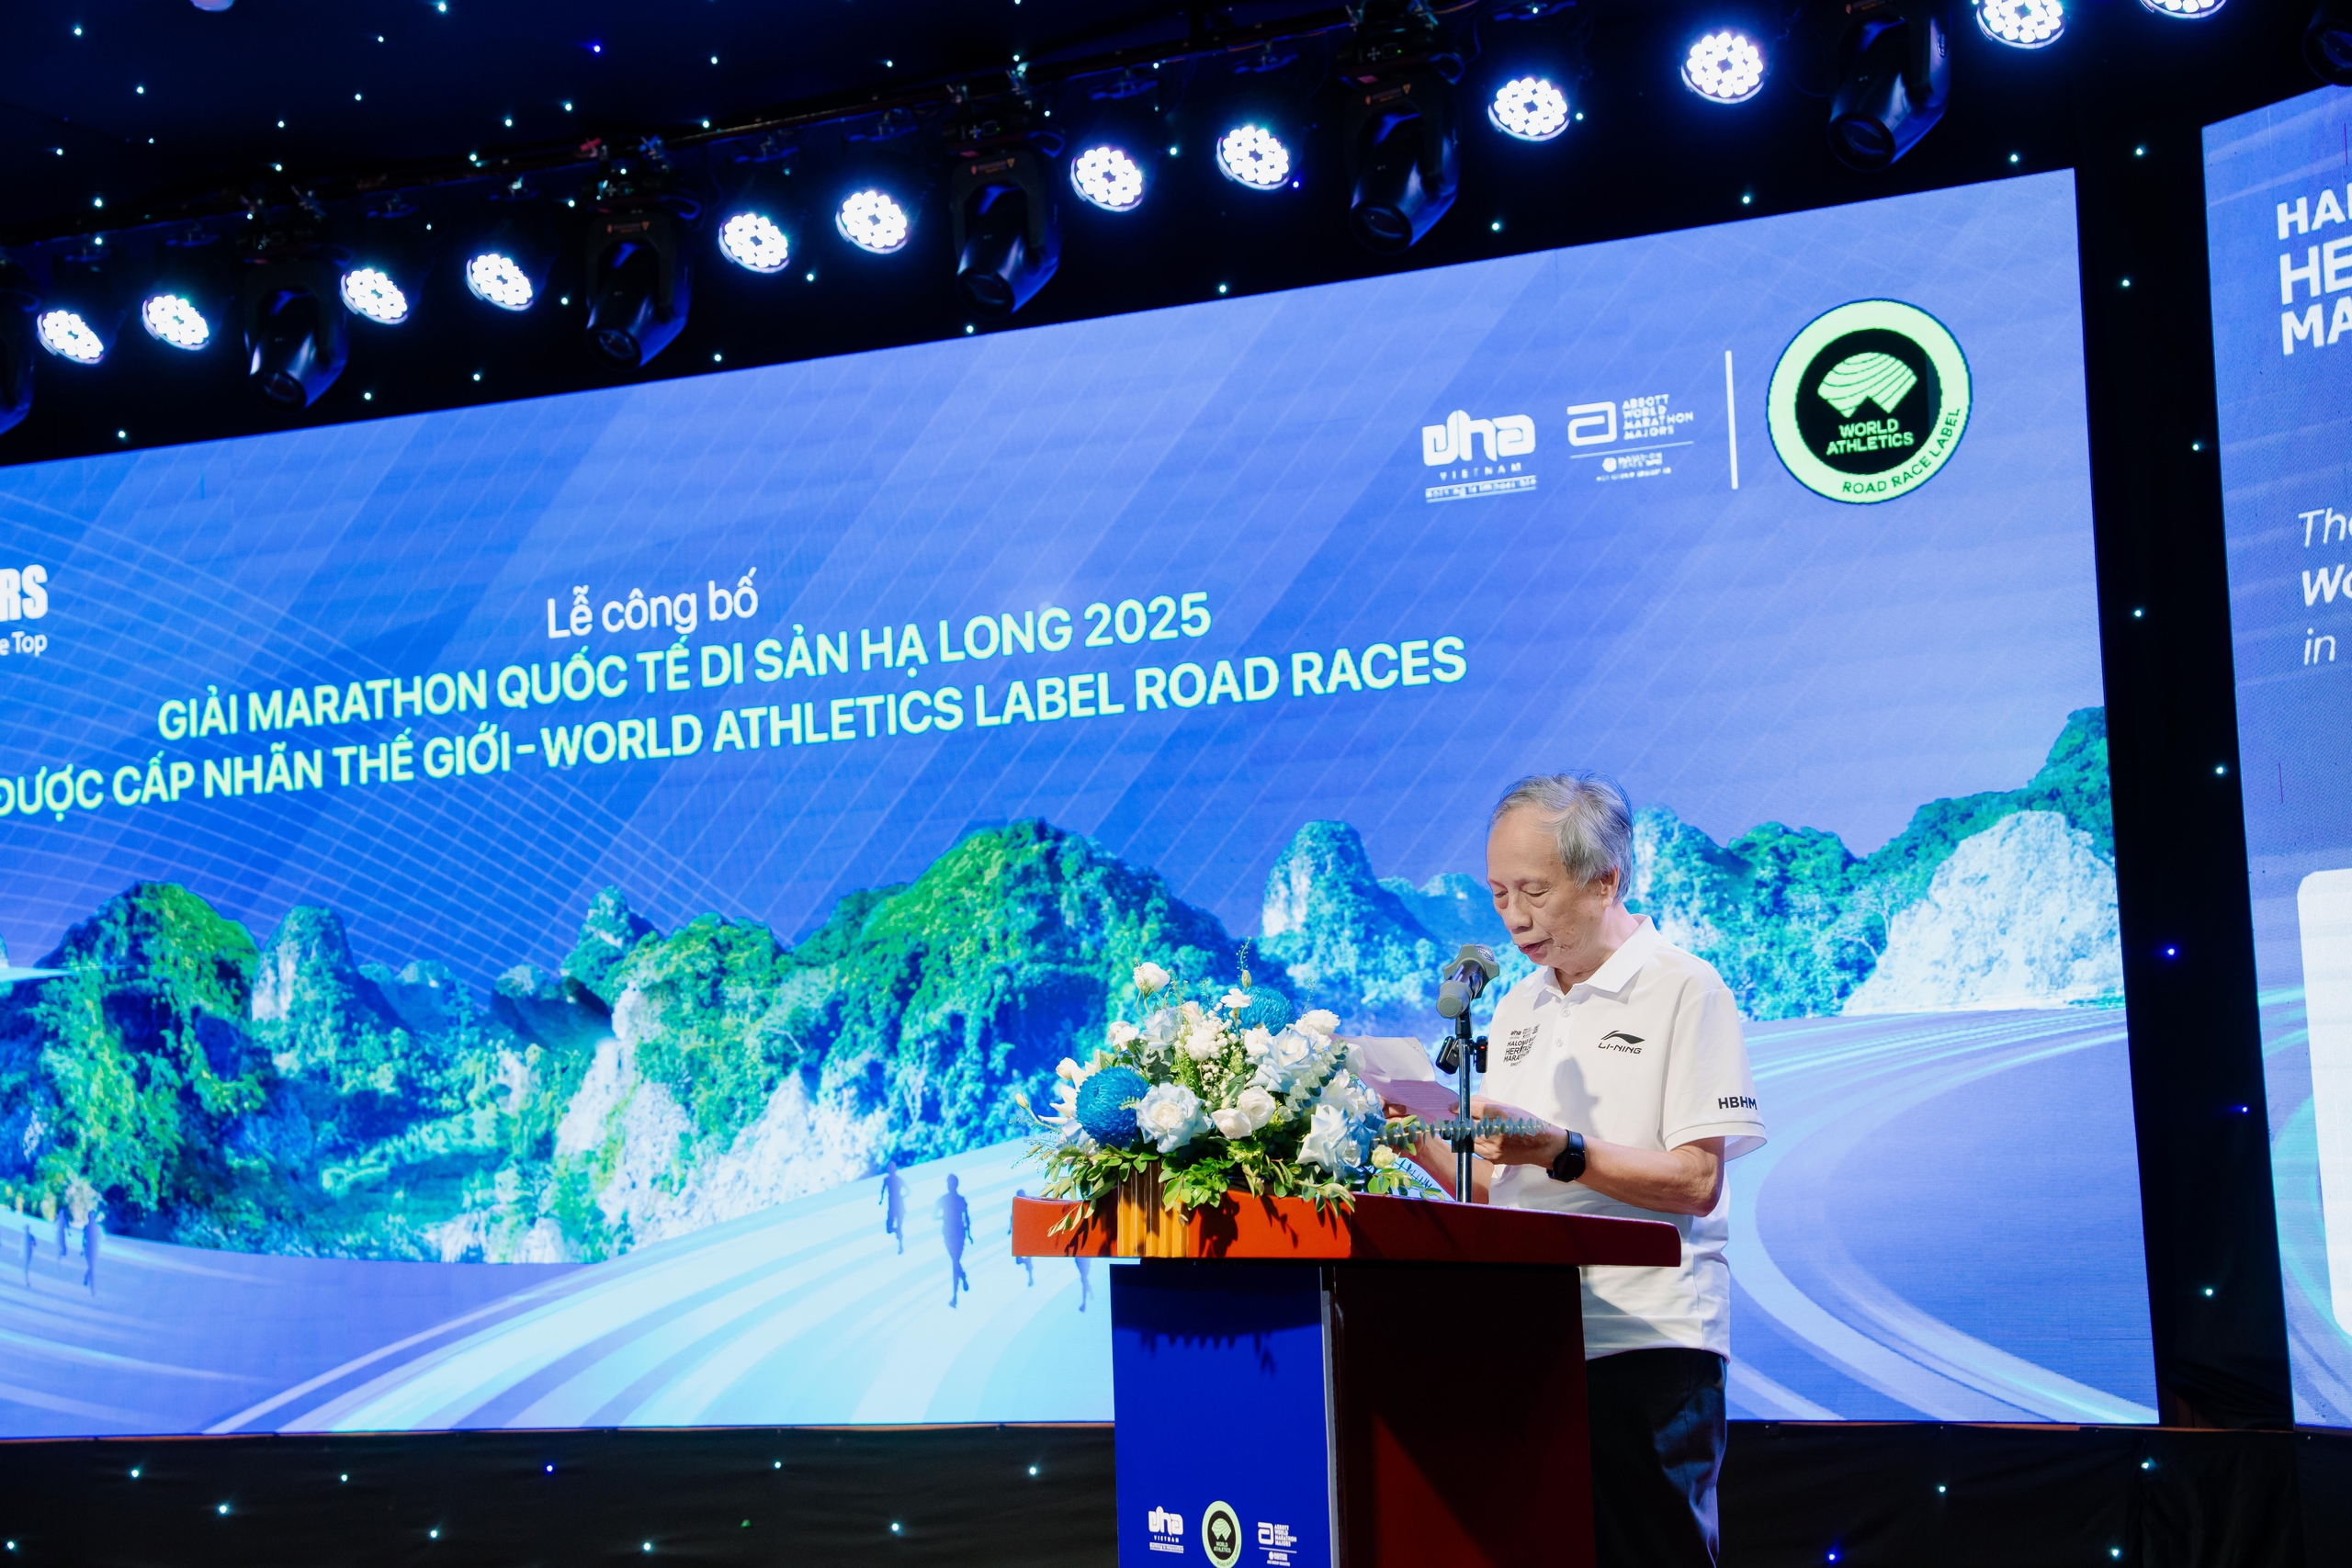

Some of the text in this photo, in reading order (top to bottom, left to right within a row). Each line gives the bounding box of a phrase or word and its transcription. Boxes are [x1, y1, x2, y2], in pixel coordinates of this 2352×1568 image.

[2277, 183, 2352, 241] HA
[1623, 394, 1669, 409] ABBOTT
[1623, 405, 1667, 419] WORLD
[1623, 412, 1694, 430] MARATHON
[1839, 418, 1899, 437] WORLD
[1623, 425, 1674, 440] MAJORS
[1826, 432, 1914, 456] ATHLETICS
[1842, 408, 1961, 494] ROAD RACE LABEL
[1440, 462, 1521, 480] VIETNAM
[2298, 507, 2352, 547] Th
[548, 567, 758, 638] Lễ công bố
[11, 630, 48, 658] Top
[2303, 627, 2335, 665] in
[158, 591, 1212, 739] GIẢI MARATHON QUỐC TẾ DI SẢN HẠ LONG 2025
[112, 750, 196, 806] CẤP
[204, 742, 322, 798] NHÃN
[332, 728, 414, 785] THẾ
[424, 721, 511, 778] GIỚI
[540, 714, 703, 768] WORLD
[713, 687, 964, 752] ATHLETICS
[975, 671, 1125, 727] LABEL
[1135, 656, 1280, 712] ROAD
[1291, 636, 1467, 697] RACES
[1598, 1042, 1643, 1055] LI-NING
[1717, 1095, 1758, 1111] HBHM
[1153, 1534, 1180, 1543] VIETNAM
